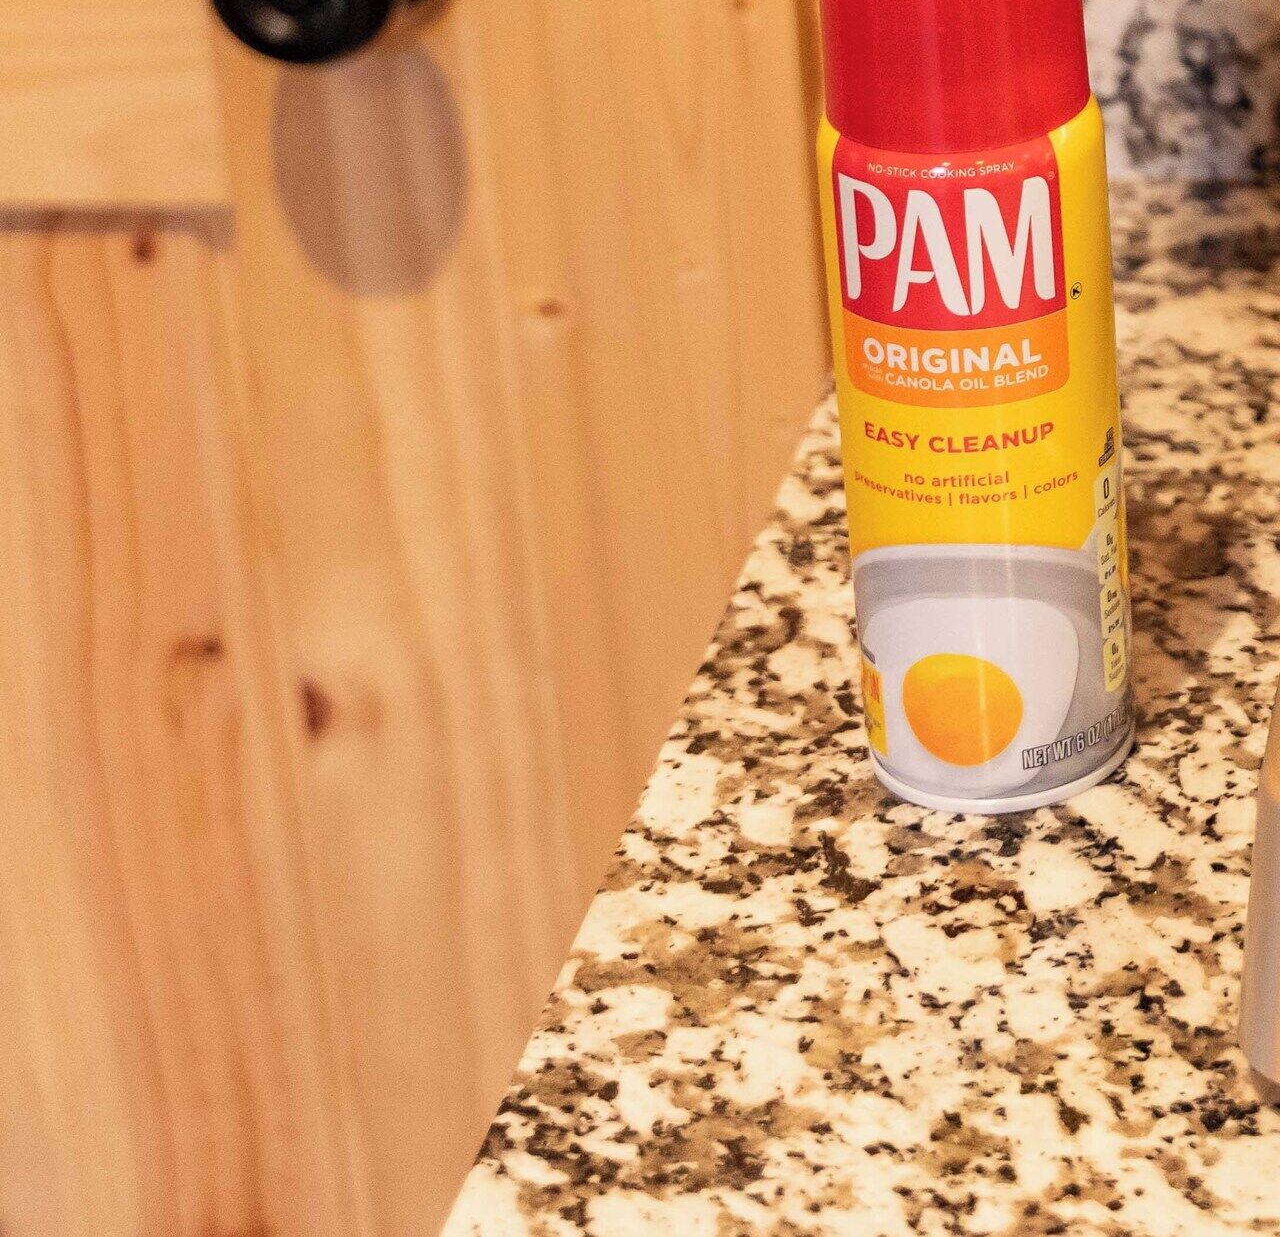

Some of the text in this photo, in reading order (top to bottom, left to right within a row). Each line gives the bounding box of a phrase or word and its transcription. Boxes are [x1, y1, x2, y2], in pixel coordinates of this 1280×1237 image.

[868, 161, 1015, 179] NO-STICK COOKING SPRAY
[838, 172, 1056, 316] PAM
[863, 337, 1042, 374] ORIGINAL
[885, 372, 955, 391] CANOLA
[959, 378, 989, 390] OIL
[994, 364, 1049, 388] BLEND
[864, 421, 1054, 453] EASY CLEANUP
[854, 470, 1079, 505] preservatives flavors colors
[904, 471, 1009, 487] no artificial
[1022, 744, 1050, 770] NET
[1052, 736, 1073, 761] WT
[1076, 731, 1085, 753] 6
[1088, 721, 1101, 746] OZ
